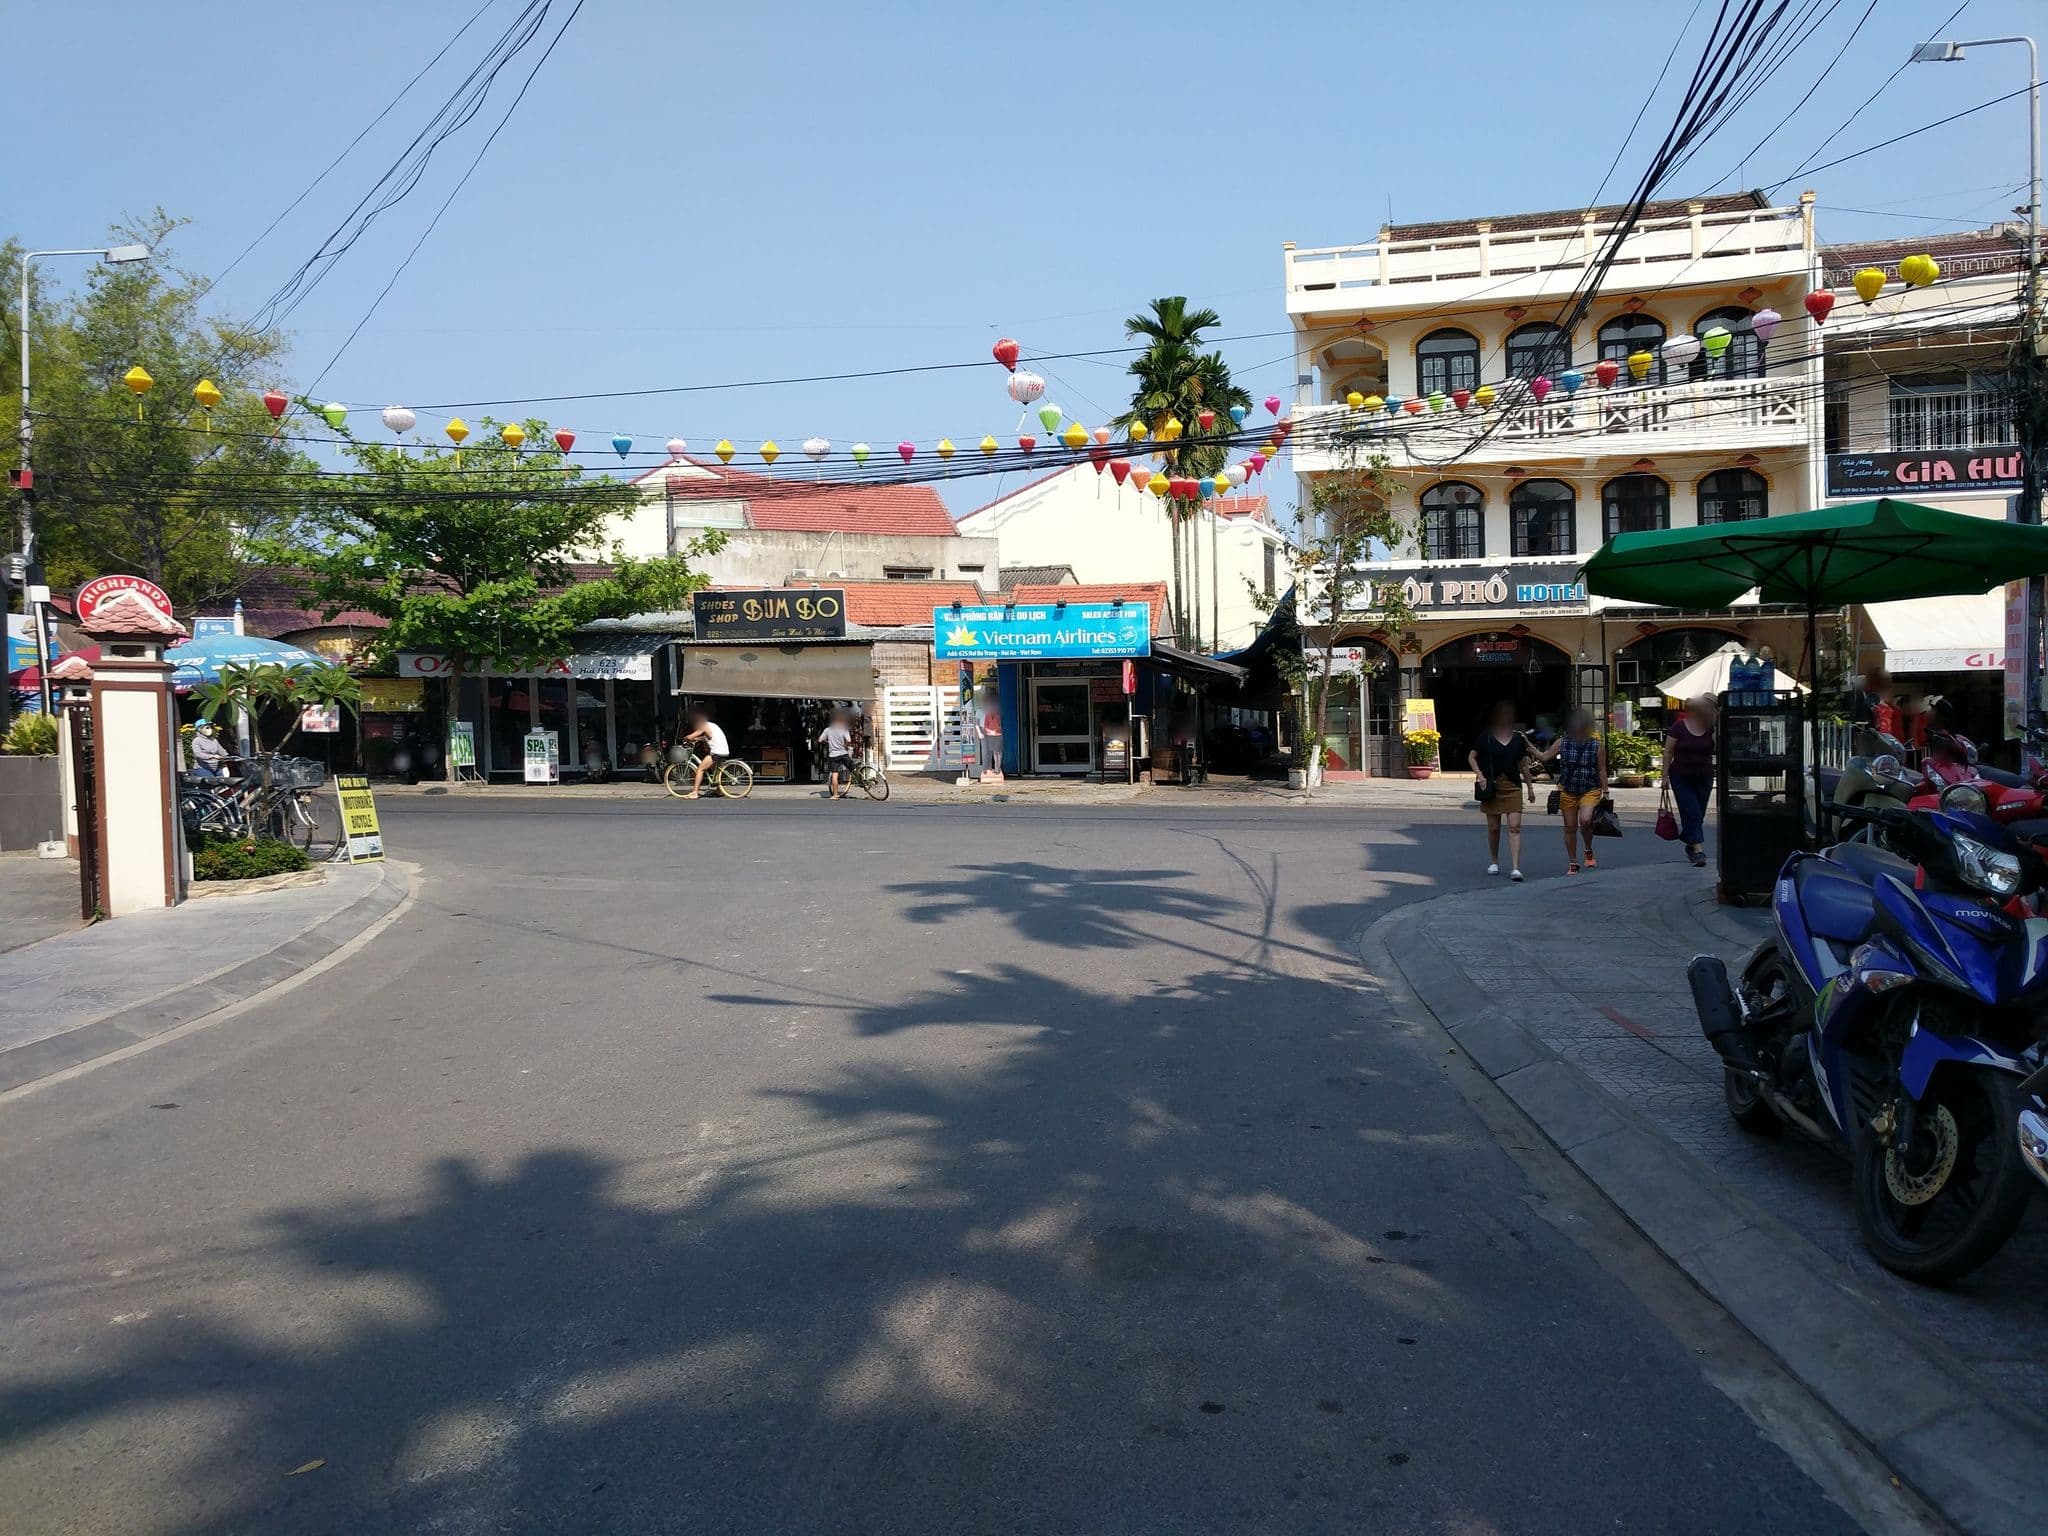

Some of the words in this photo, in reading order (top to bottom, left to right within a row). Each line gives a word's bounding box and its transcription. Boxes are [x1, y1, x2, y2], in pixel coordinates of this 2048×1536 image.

[1967, 451, 2024, 480] HƯ
[83, 579, 168, 609] HIGHLANDS
[1440, 569, 1509, 604] PHỐ
[1517, 583, 1587, 602] HOTEL
[700, 601, 736, 610] SHOES
[742, 598, 790, 621] BUM
[795, 597, 839, 620] BO
[709, 613, 739, 623] SHOP
[982, 631, 1051, 646] Vietnam
[1053, 628, 1116, 645] Airlines
[599, 659, 617, 668] 623
[1892, 656, 1953, 667] TAILOR
[527, 739, 546, 752] SPA
[342, 795, 373, 810] MOTORBIKE
[1955, 909, 2012, 931] movistar
